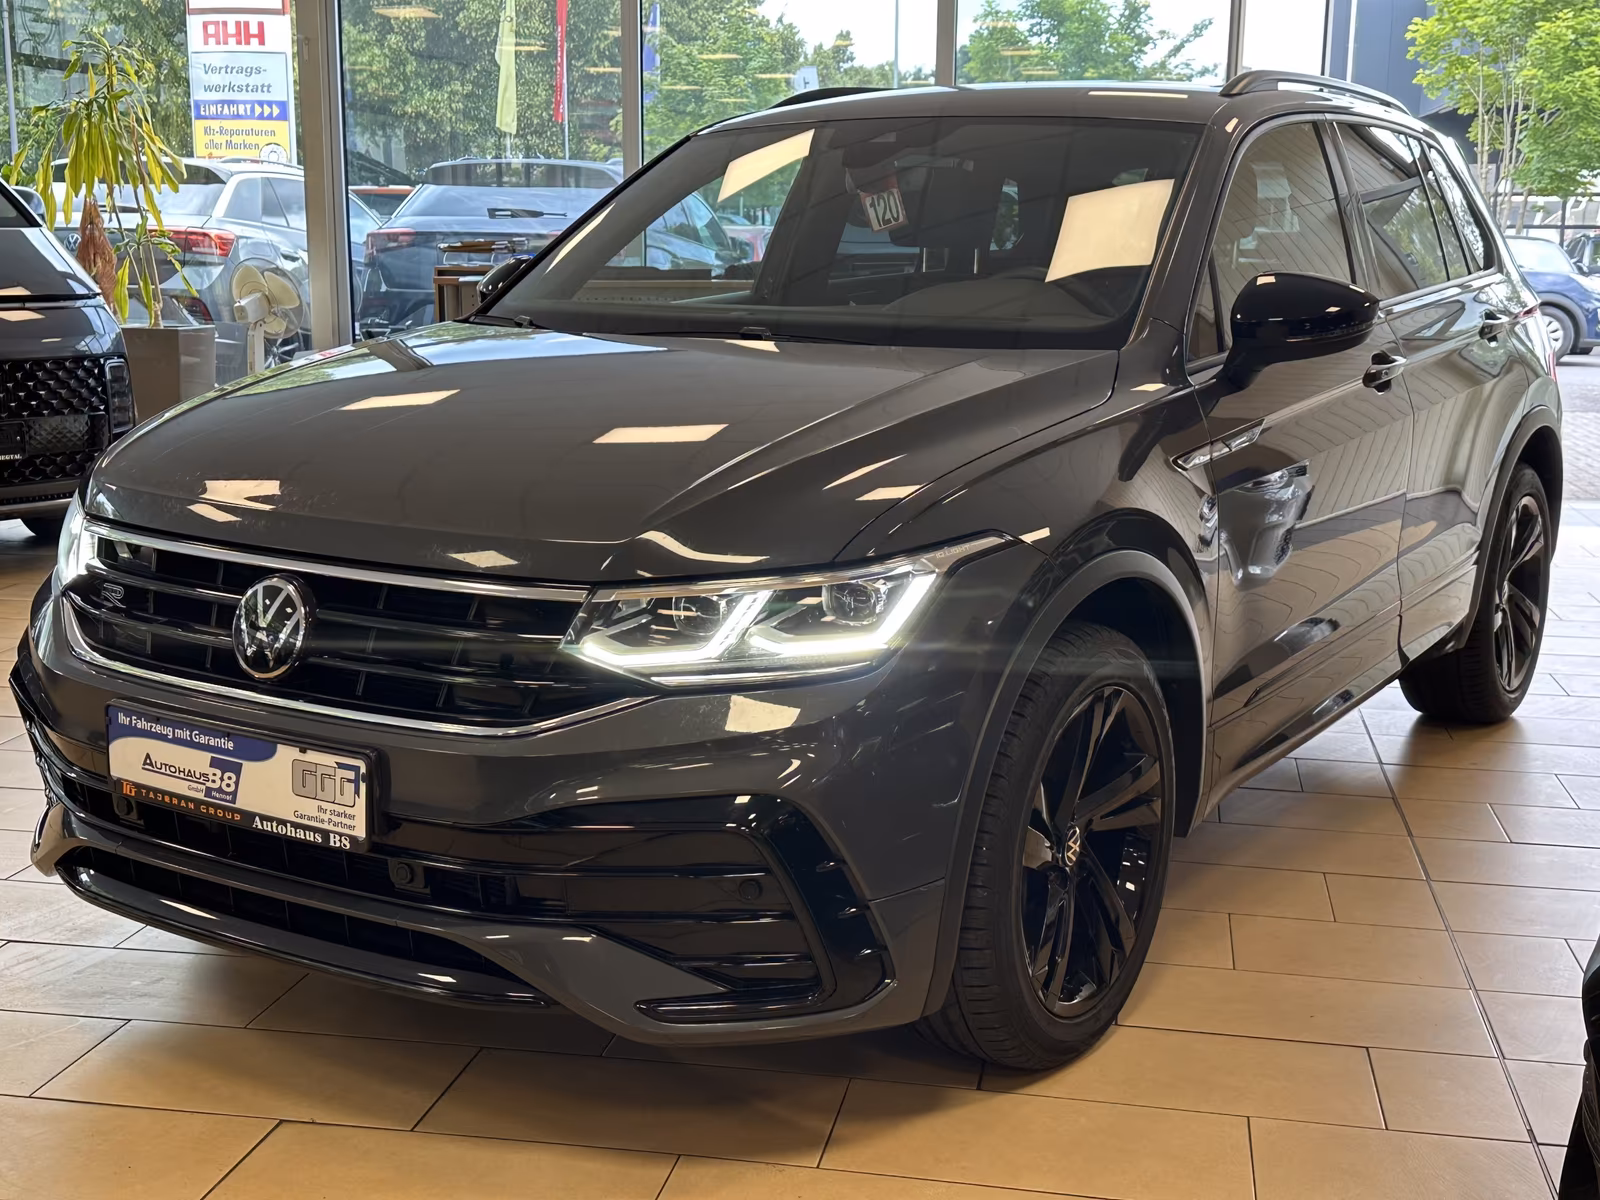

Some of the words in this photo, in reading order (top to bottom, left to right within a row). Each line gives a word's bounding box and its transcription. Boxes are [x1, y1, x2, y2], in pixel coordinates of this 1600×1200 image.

[203, 20, 266, 46] AHH
[203, 63, 267, 77] Vertrags-
[203, 81, 272, 93] werkstatt
[200, 103, 251, 116] EINFAHRT
[203, 126, 276, 138] Kfz-Reparaturen
[225, 139, 260, 151] Marken
[869, 190, 900, 227] 120
[117, 712, 130, 725] Ihr
[131, 715, 173, 739] Fahrzeug
[174, 728, 191, 741] mit
[191, 731, 234, 751] Garantie
[187, 784, 205, 795] GmbH
[211, 790, 233, 801] Hennef
[200, 804, 242, 821] GROUP
[293, 810, 357, 832] Garantie-Partner
[317, 804, 328, 815] Ihr
[329, 809, 356, 821] starker
[252, 815, 323, 843] Autohaus
[329, 832, 351, 850] B8
